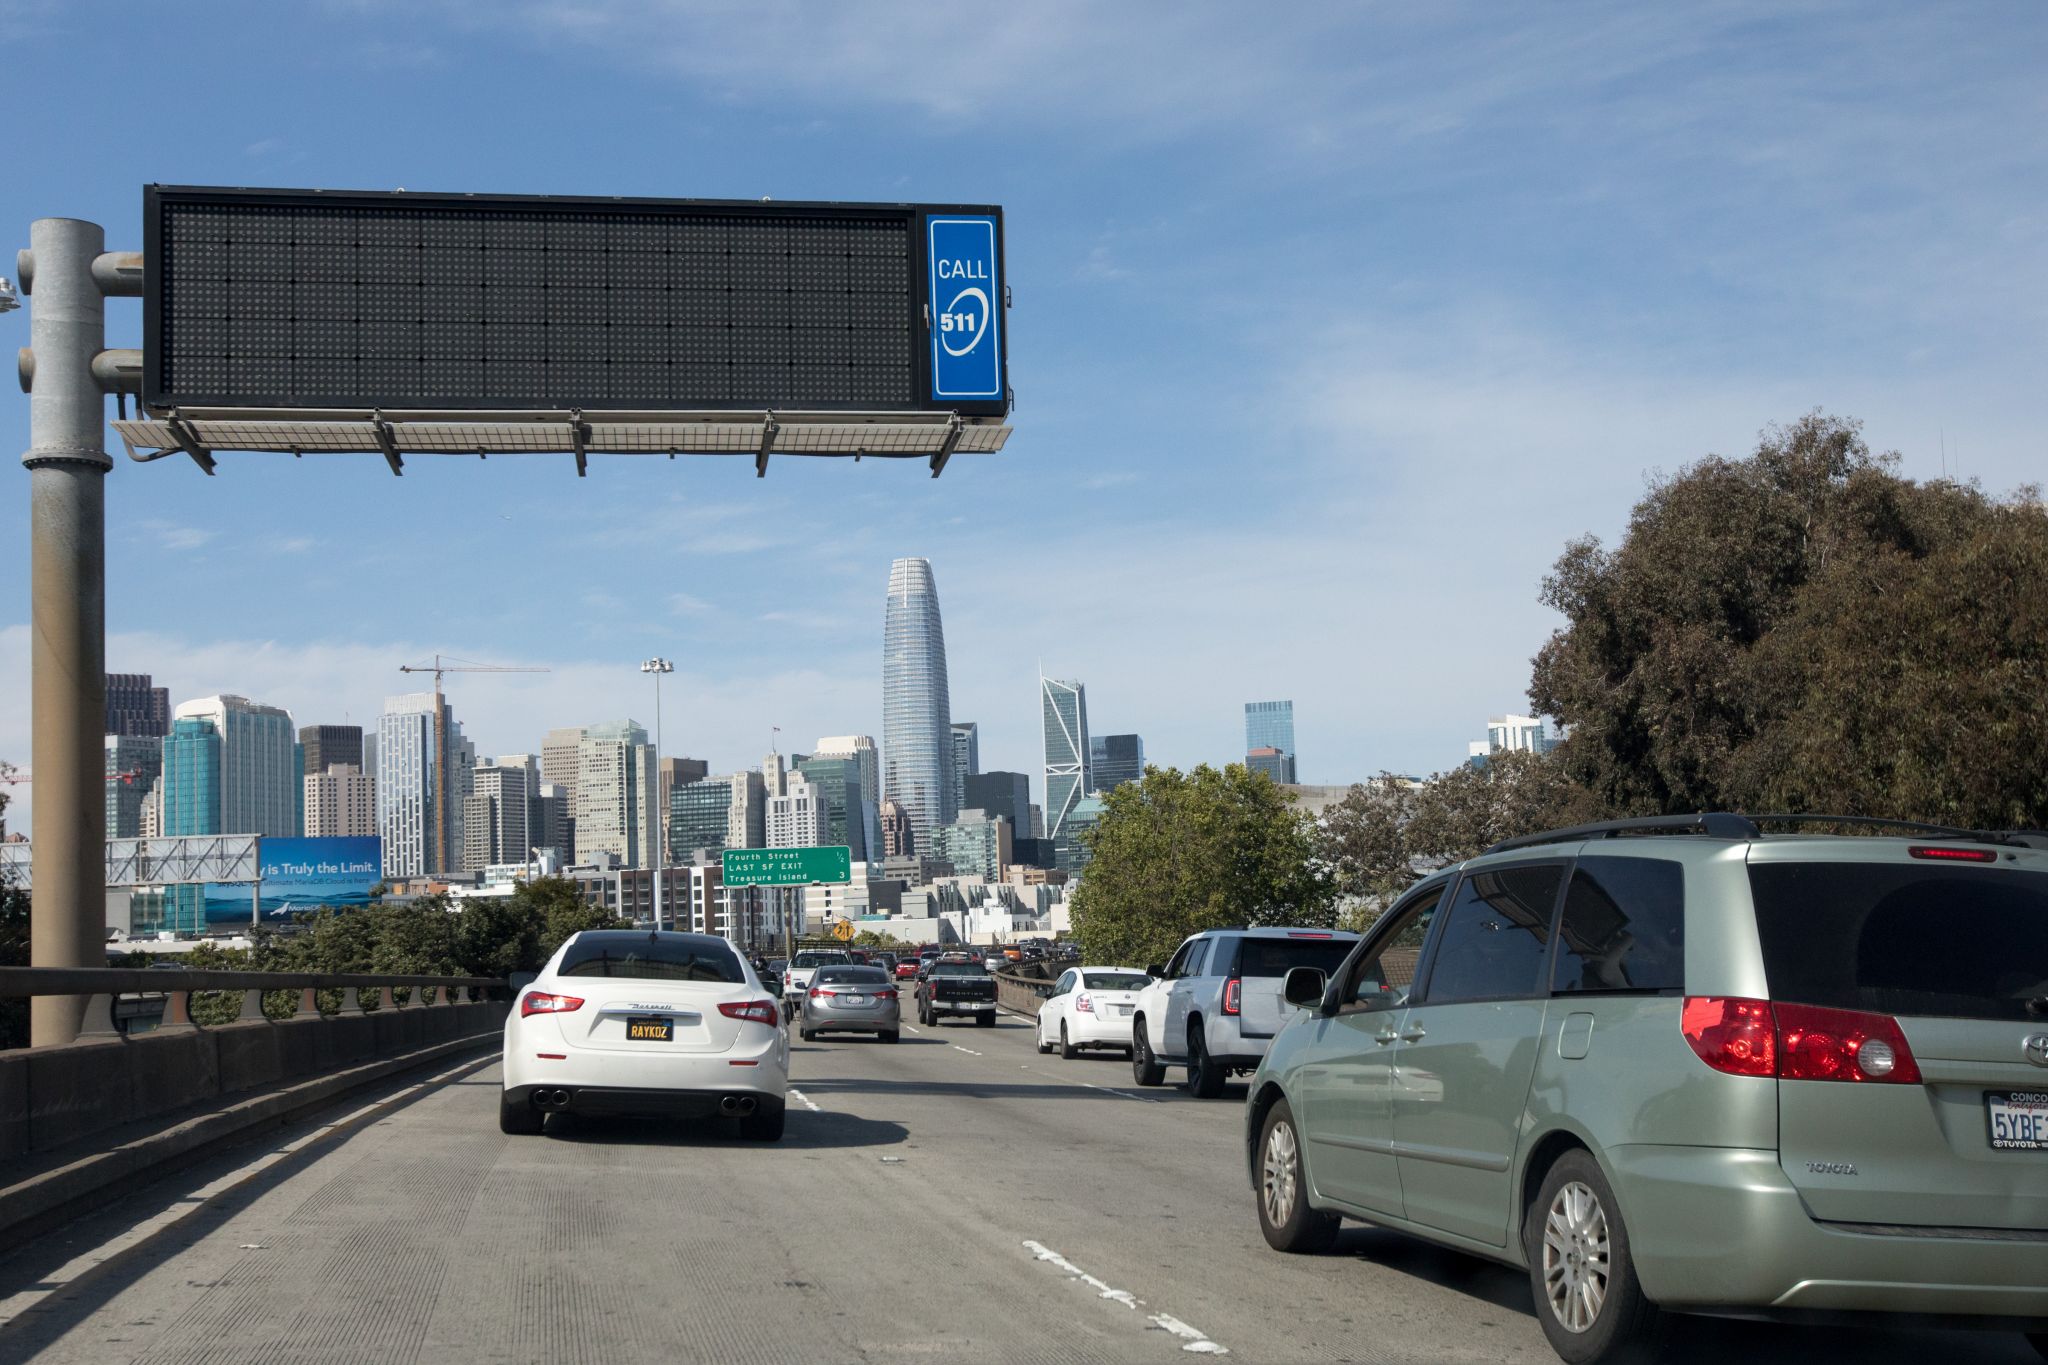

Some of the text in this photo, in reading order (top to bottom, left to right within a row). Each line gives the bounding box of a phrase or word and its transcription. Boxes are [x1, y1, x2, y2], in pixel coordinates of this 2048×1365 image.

[939, 259, 988, 279] CALL
[940, 312, 975, 332] 511
[728, 853, 761, 861] Fourth
[268, 864, 278, 874] is
[281, 862, 314, 876] Truly
[317, 861, 338, 874] the
[341, 861, 377, 874] Limit.
[729, 862, 803, 872] LAST SF EXIT
[729, 874, 772, 882] Treasure
[779, 873, 808, 881] Island
[1806, 1161, 1858, 1176] TOYOTA
